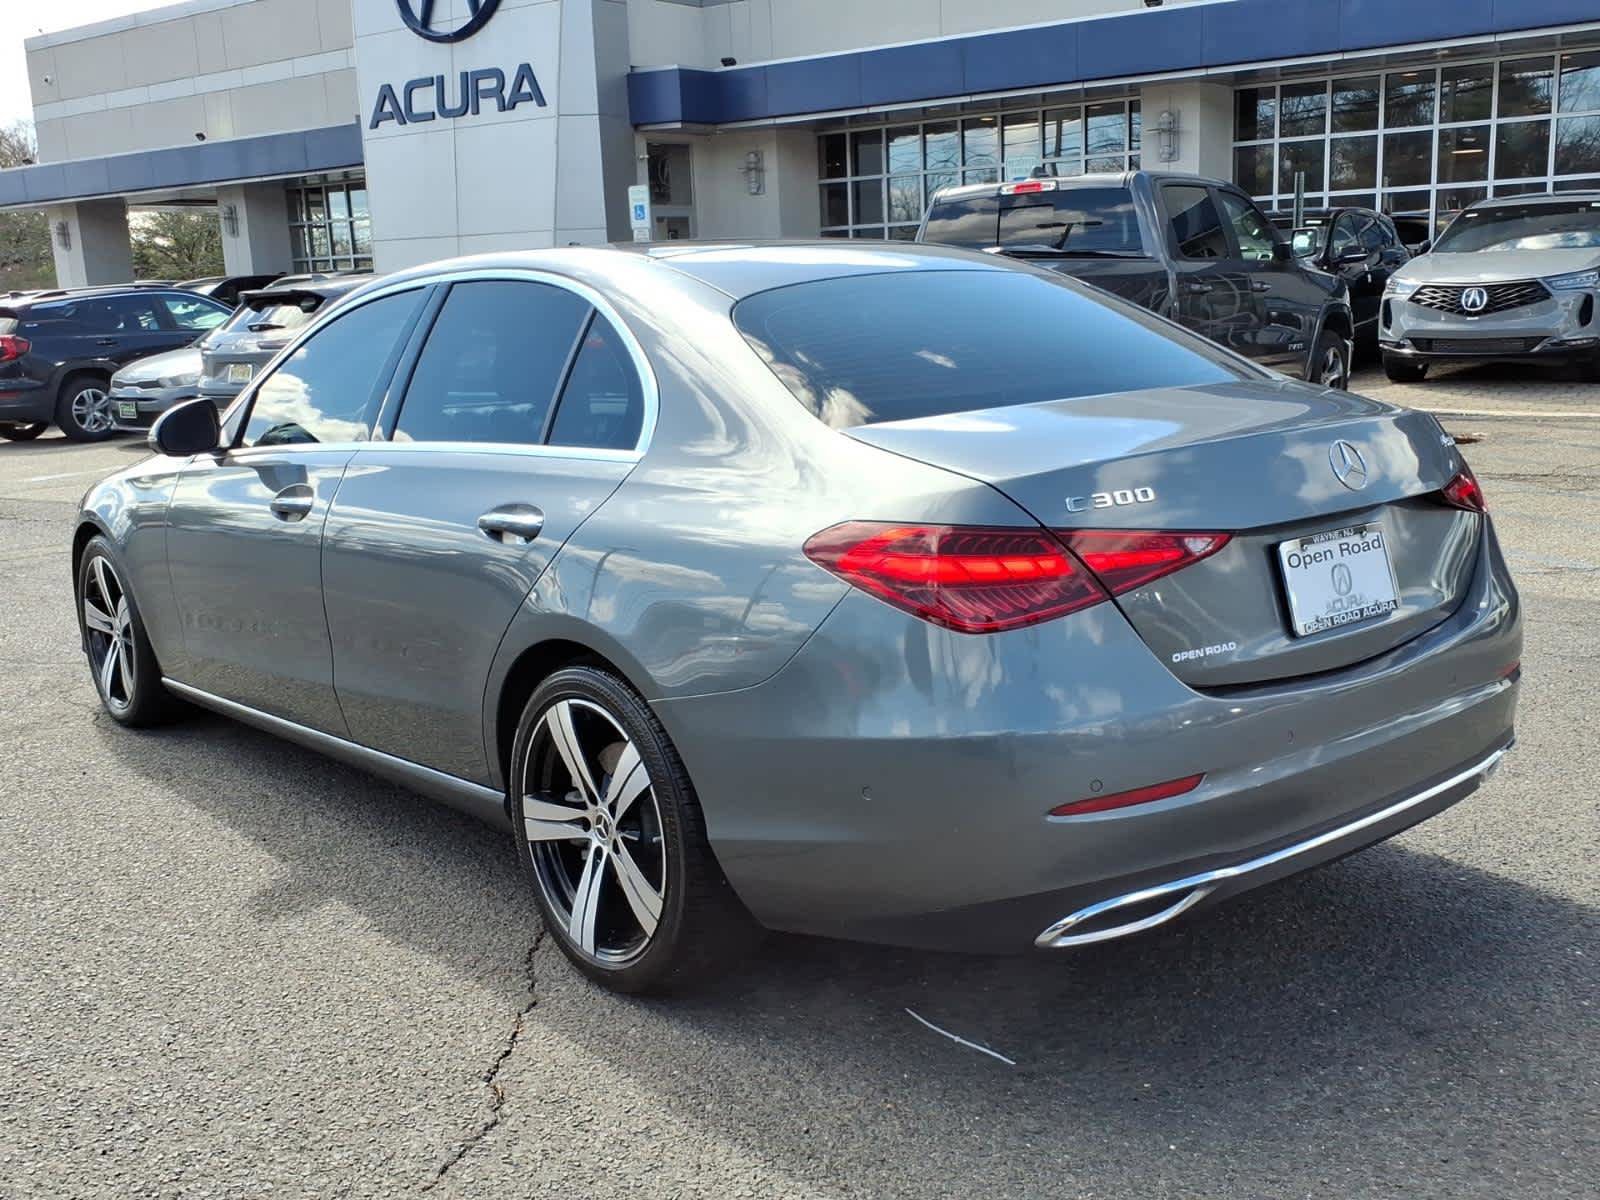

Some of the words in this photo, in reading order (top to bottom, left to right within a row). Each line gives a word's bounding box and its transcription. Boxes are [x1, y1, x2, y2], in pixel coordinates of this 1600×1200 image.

[369, 63, 548, 130] ACURA
[1065, 496, 1088, 512] C
[1091, 487, 1155, 509] 300
[1287, 548, 1334, 569] Open
[1339, 535, 1381, 557] Road
[1305, 616, 1332, 633] OPEN
[1333, 609, 1361, 626] ROAD
[1362, 601, 1397, 618] ACURA
[1172, 648, 1204, 663] OPEN
[1205, 641, 1237, 656] ROAD
